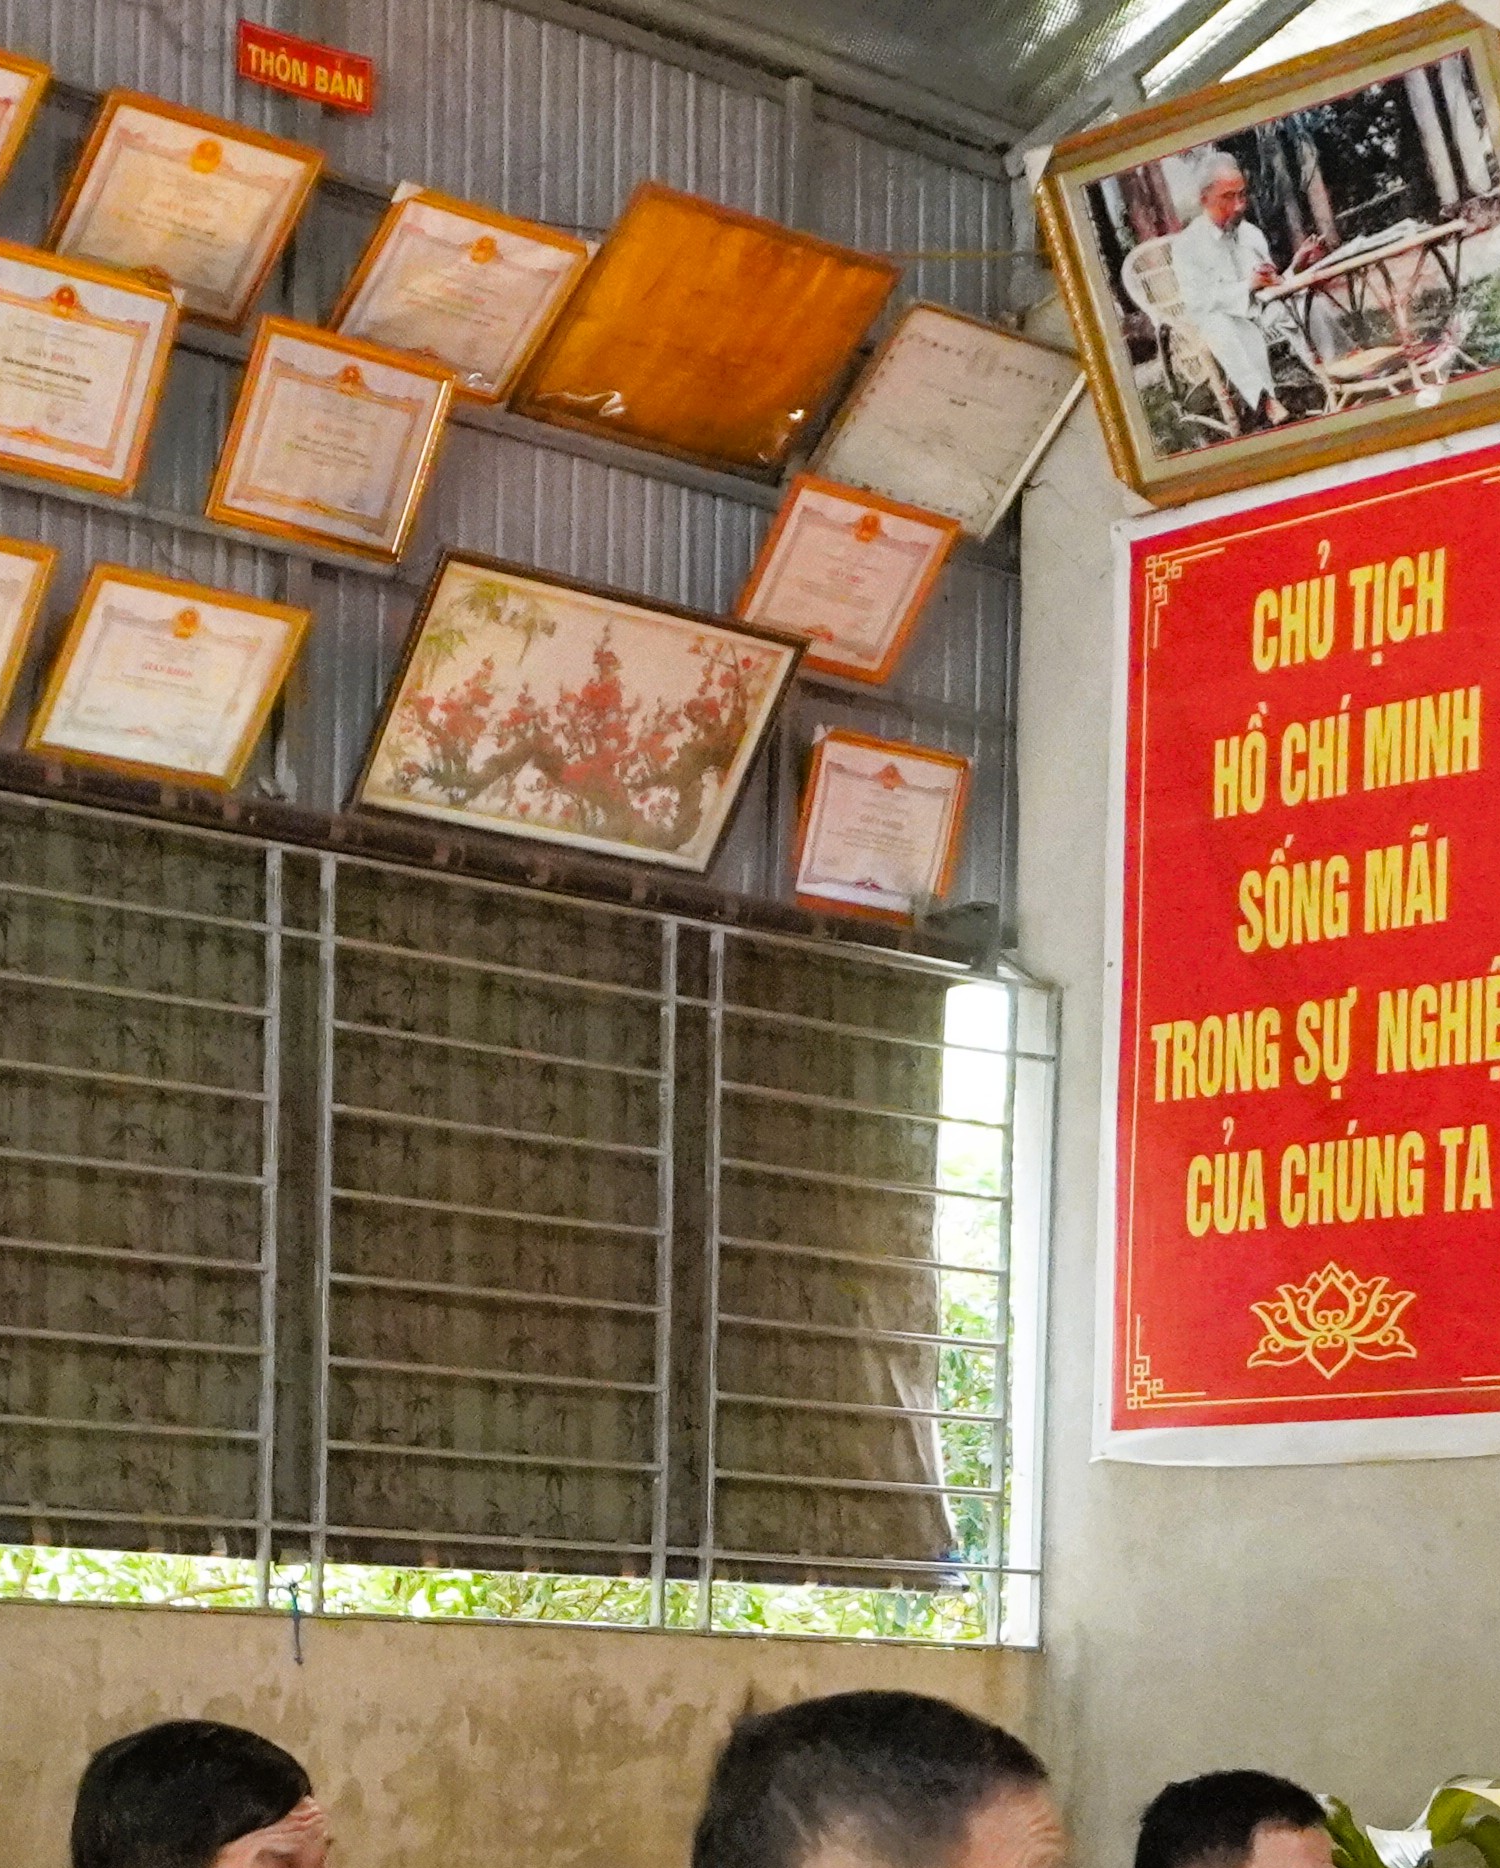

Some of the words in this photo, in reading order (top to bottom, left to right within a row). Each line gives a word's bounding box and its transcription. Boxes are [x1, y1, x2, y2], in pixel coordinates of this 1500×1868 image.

[246, 43, 308, 88] THÔN
[314, 59, 364, 103] BẢN
[1252, 539, 1334, 672] CHỦ
[1350, 549, 1445, 666] TỊCH
[1213, 701, 1268, 819] HỒ
[1279, 693, 1351, 803] CHÍ
[1363, 687, 1481, 795] MINH
[1236, 833, 1350, 955] SỐNG
[1362, 835, 1447, 944] MÃI
[1150, 1012, 1280, 1103] TRONG
[1295, 989, 1354, 1100] SỰ
[1186, 1117, 1267, 1238] CỦA
[1279, 1117, 1423, 1227] CHÚNG
[1441, 1124, 1492, 1213] TA
